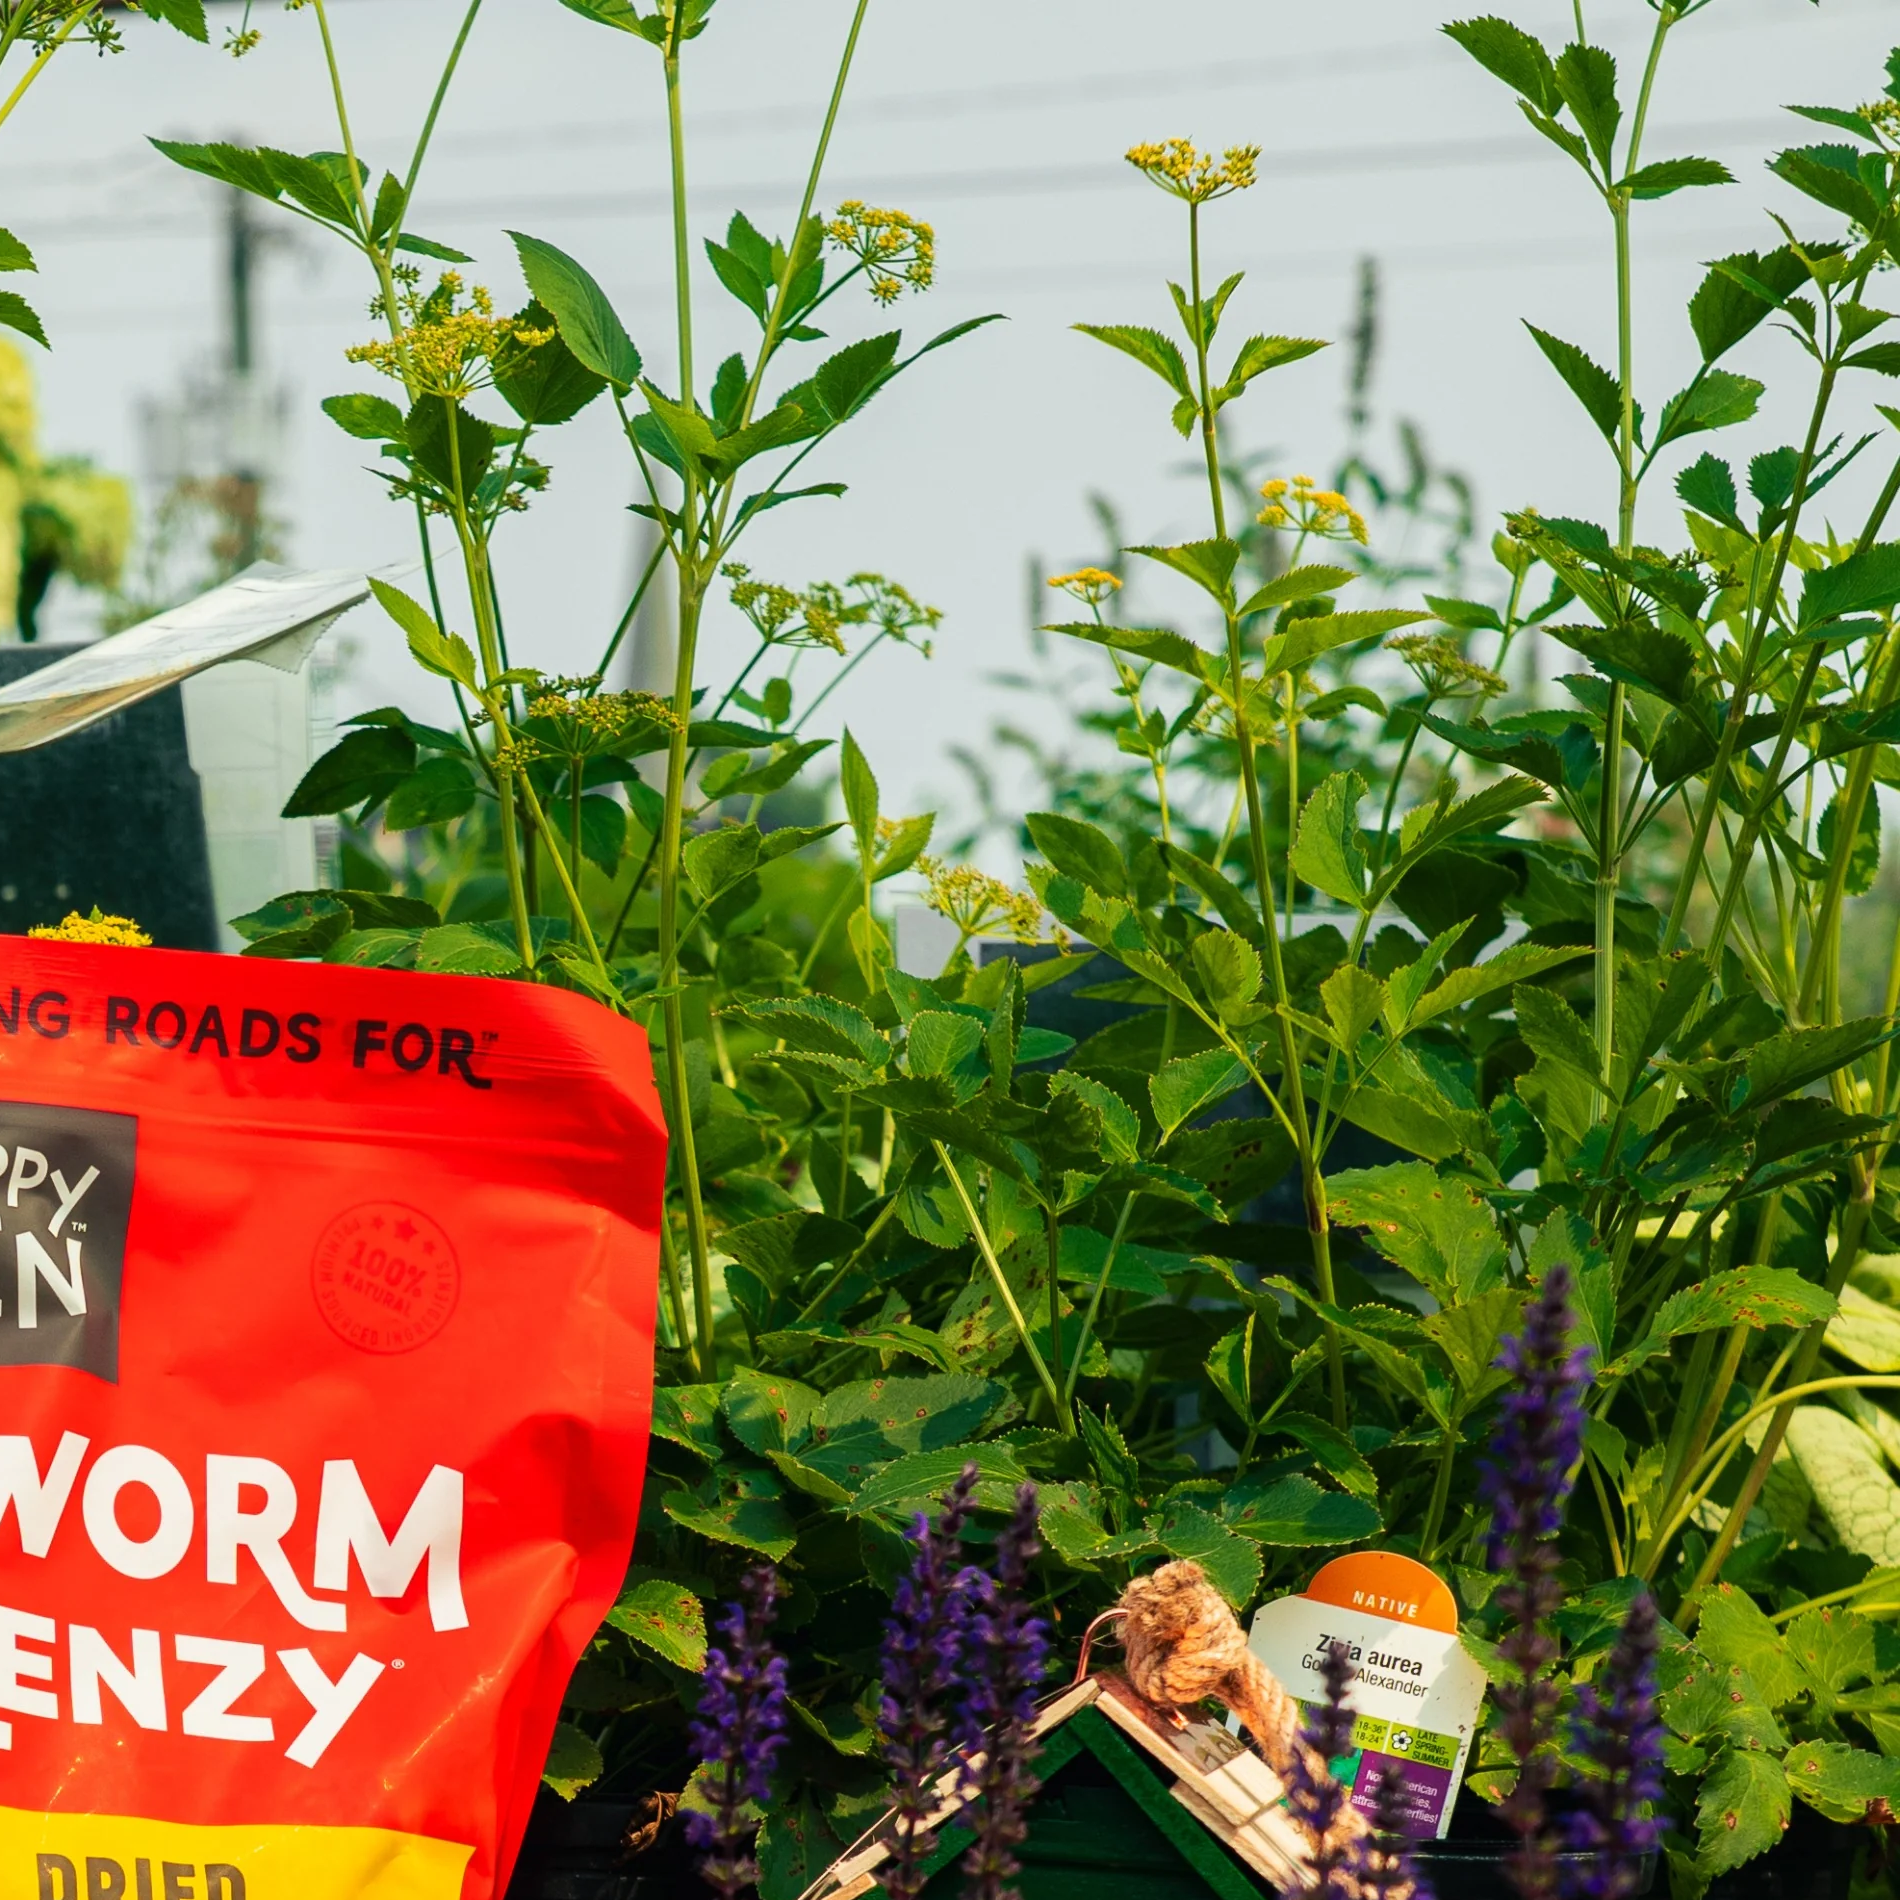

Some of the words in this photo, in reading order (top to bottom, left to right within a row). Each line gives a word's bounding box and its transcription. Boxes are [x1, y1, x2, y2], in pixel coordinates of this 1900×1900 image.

[106, 995, 321, 1064] ROADS
[347, 1240, 429, 1298] 100%
[342, 1270, 412, 1318] NATURAL
[1352, 1590, 1419, 1618] NATIVE
[1367, 1650, 1423, 1677] aurea
[1355, 1667, 1429, 1698] Alexander
[1416, 1730, 1439, 1742] LATE
[1411, 1751, 1449, 1767] SUMMER
[1365, 1769, 1384, 1782] Nor
